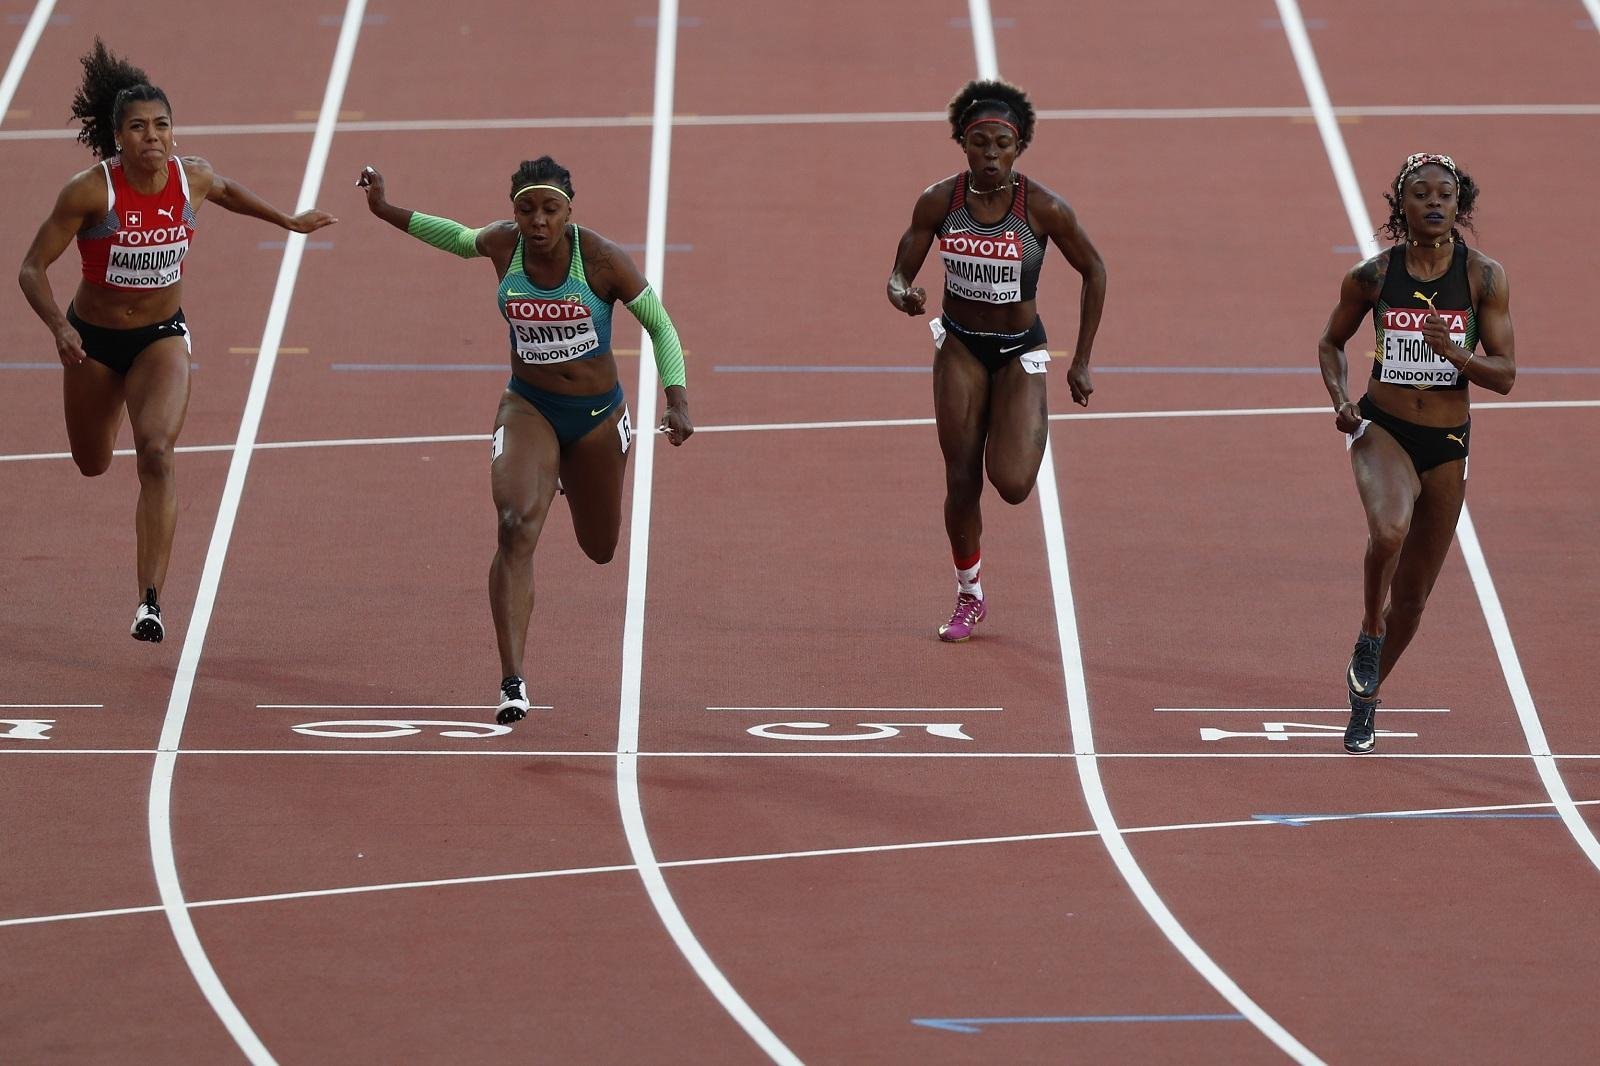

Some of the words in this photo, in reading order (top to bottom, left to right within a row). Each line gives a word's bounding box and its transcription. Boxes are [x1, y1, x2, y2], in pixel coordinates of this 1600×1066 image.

[116, 225, 187, 245] TOYOTA
[944, 238, 1019, 258] TOYOTA
[109, 273, 158, 286] LONDON
[160, 269, 179, 285] 2017
[943, 258, 1017, 284] EMMANUEL
[949, 280, 991, 300] LONDON
[992, 290, 1018, 302] 2017
[508, 302, 588, 319] TOYOTA
[515, 322, 590, 344] SANTOS
[521, 349, 569, 362] LONDON
[569, 339, 596, 356] 2017
[1385, 337, 1394, 361] E.
[1383, 368, 1434, 382] LONDON
[745, 721, 975, 741] 5
